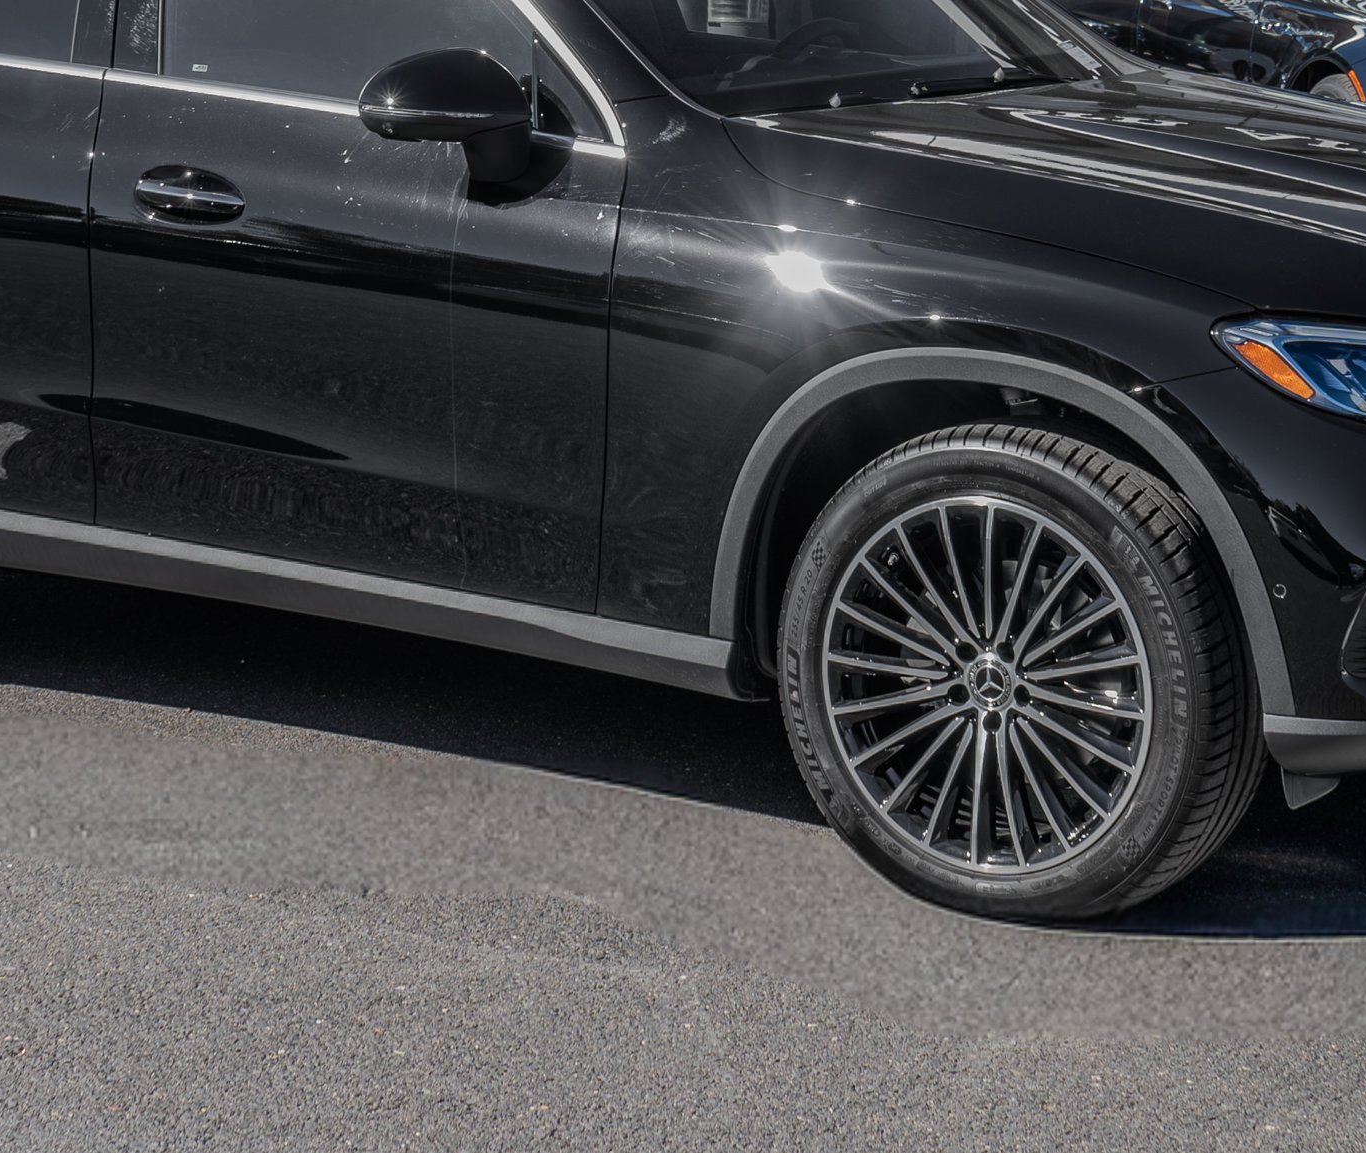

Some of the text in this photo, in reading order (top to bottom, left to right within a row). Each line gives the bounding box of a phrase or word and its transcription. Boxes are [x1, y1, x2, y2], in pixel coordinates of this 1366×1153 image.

[791, 594, 804, 638] 255/45
[803, 569, 813, 585] 20
[1138, 575, 1188, 719] MICHELIN
[787, 654, 829, 791] MICHELIN
[1154, 775, 1174, 817] SPORT
